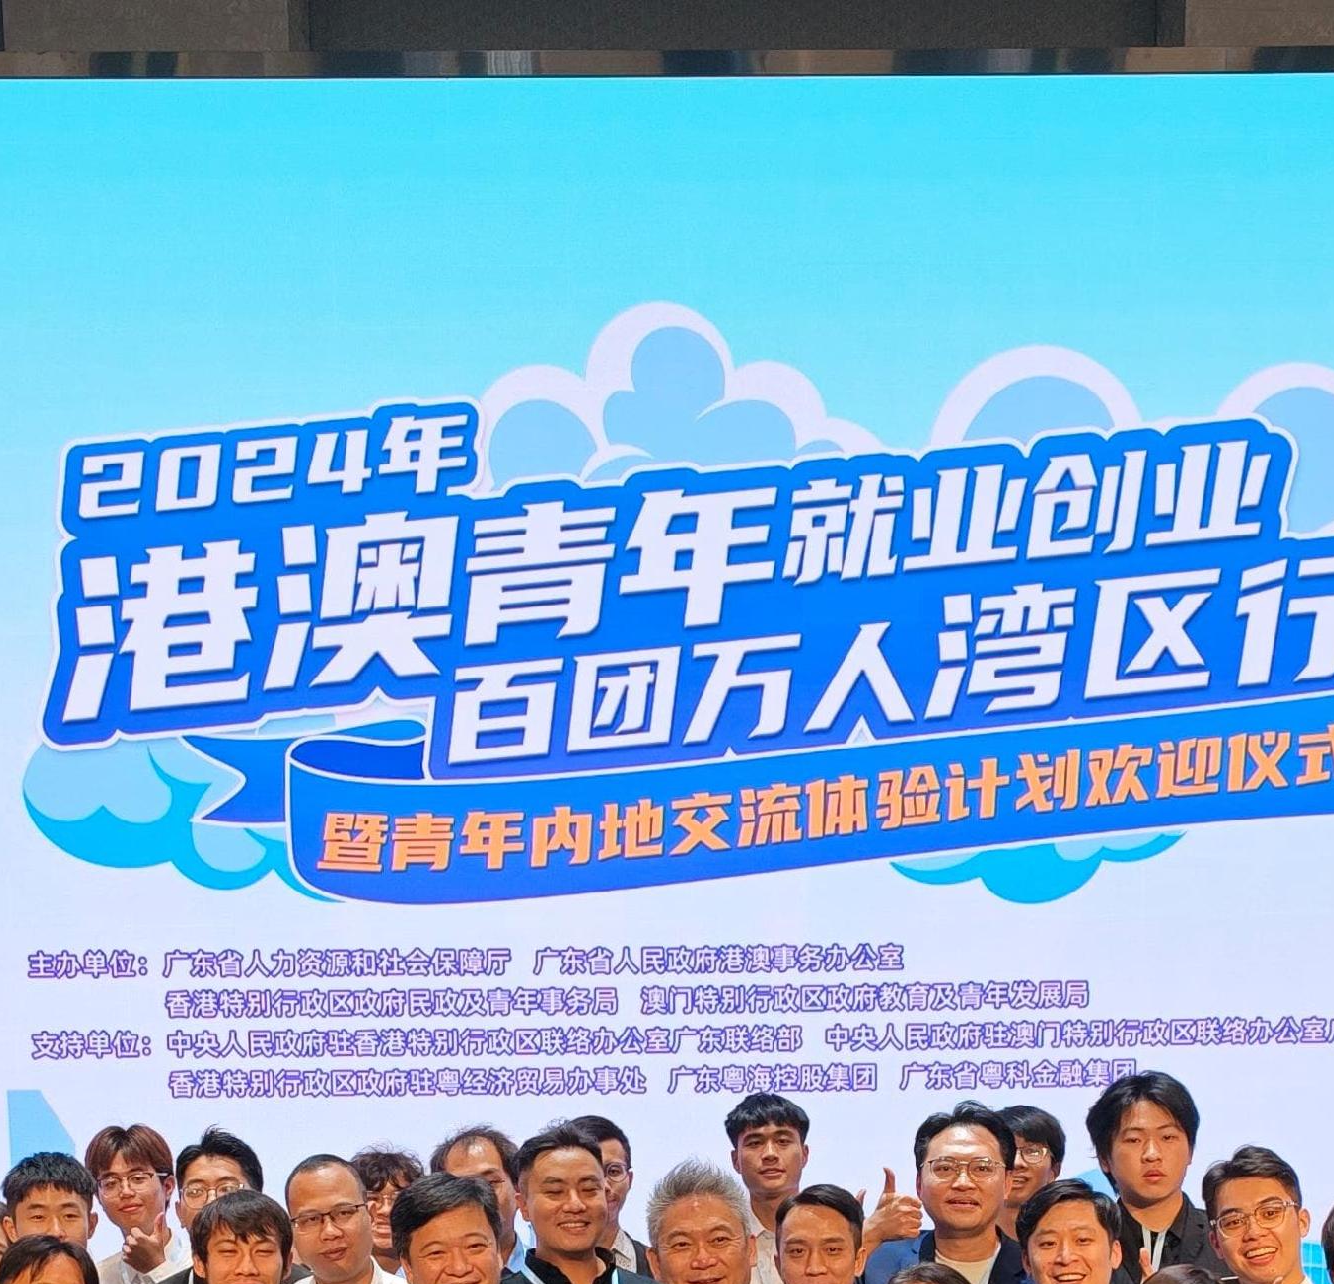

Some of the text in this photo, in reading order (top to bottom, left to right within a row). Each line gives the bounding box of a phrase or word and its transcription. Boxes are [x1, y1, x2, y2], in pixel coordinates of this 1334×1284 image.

[78, 412, 469, 519] 2024年
[70, 439, 1275, 715] 港澳青年就业创业
[534, 944, 904, 977] 广东省人民政府港澳事务办公室
[166, 981, 1089, 1018] 香港特别行政区政府民政及青年事务局 澳门特别行政区政府教育及青年发展局
[169, 1065, 646, 1099] 香港特别行政区政府驻粤经济贸易办事处
[669, 1062, 878, 1095] 广东粤海控股集团
